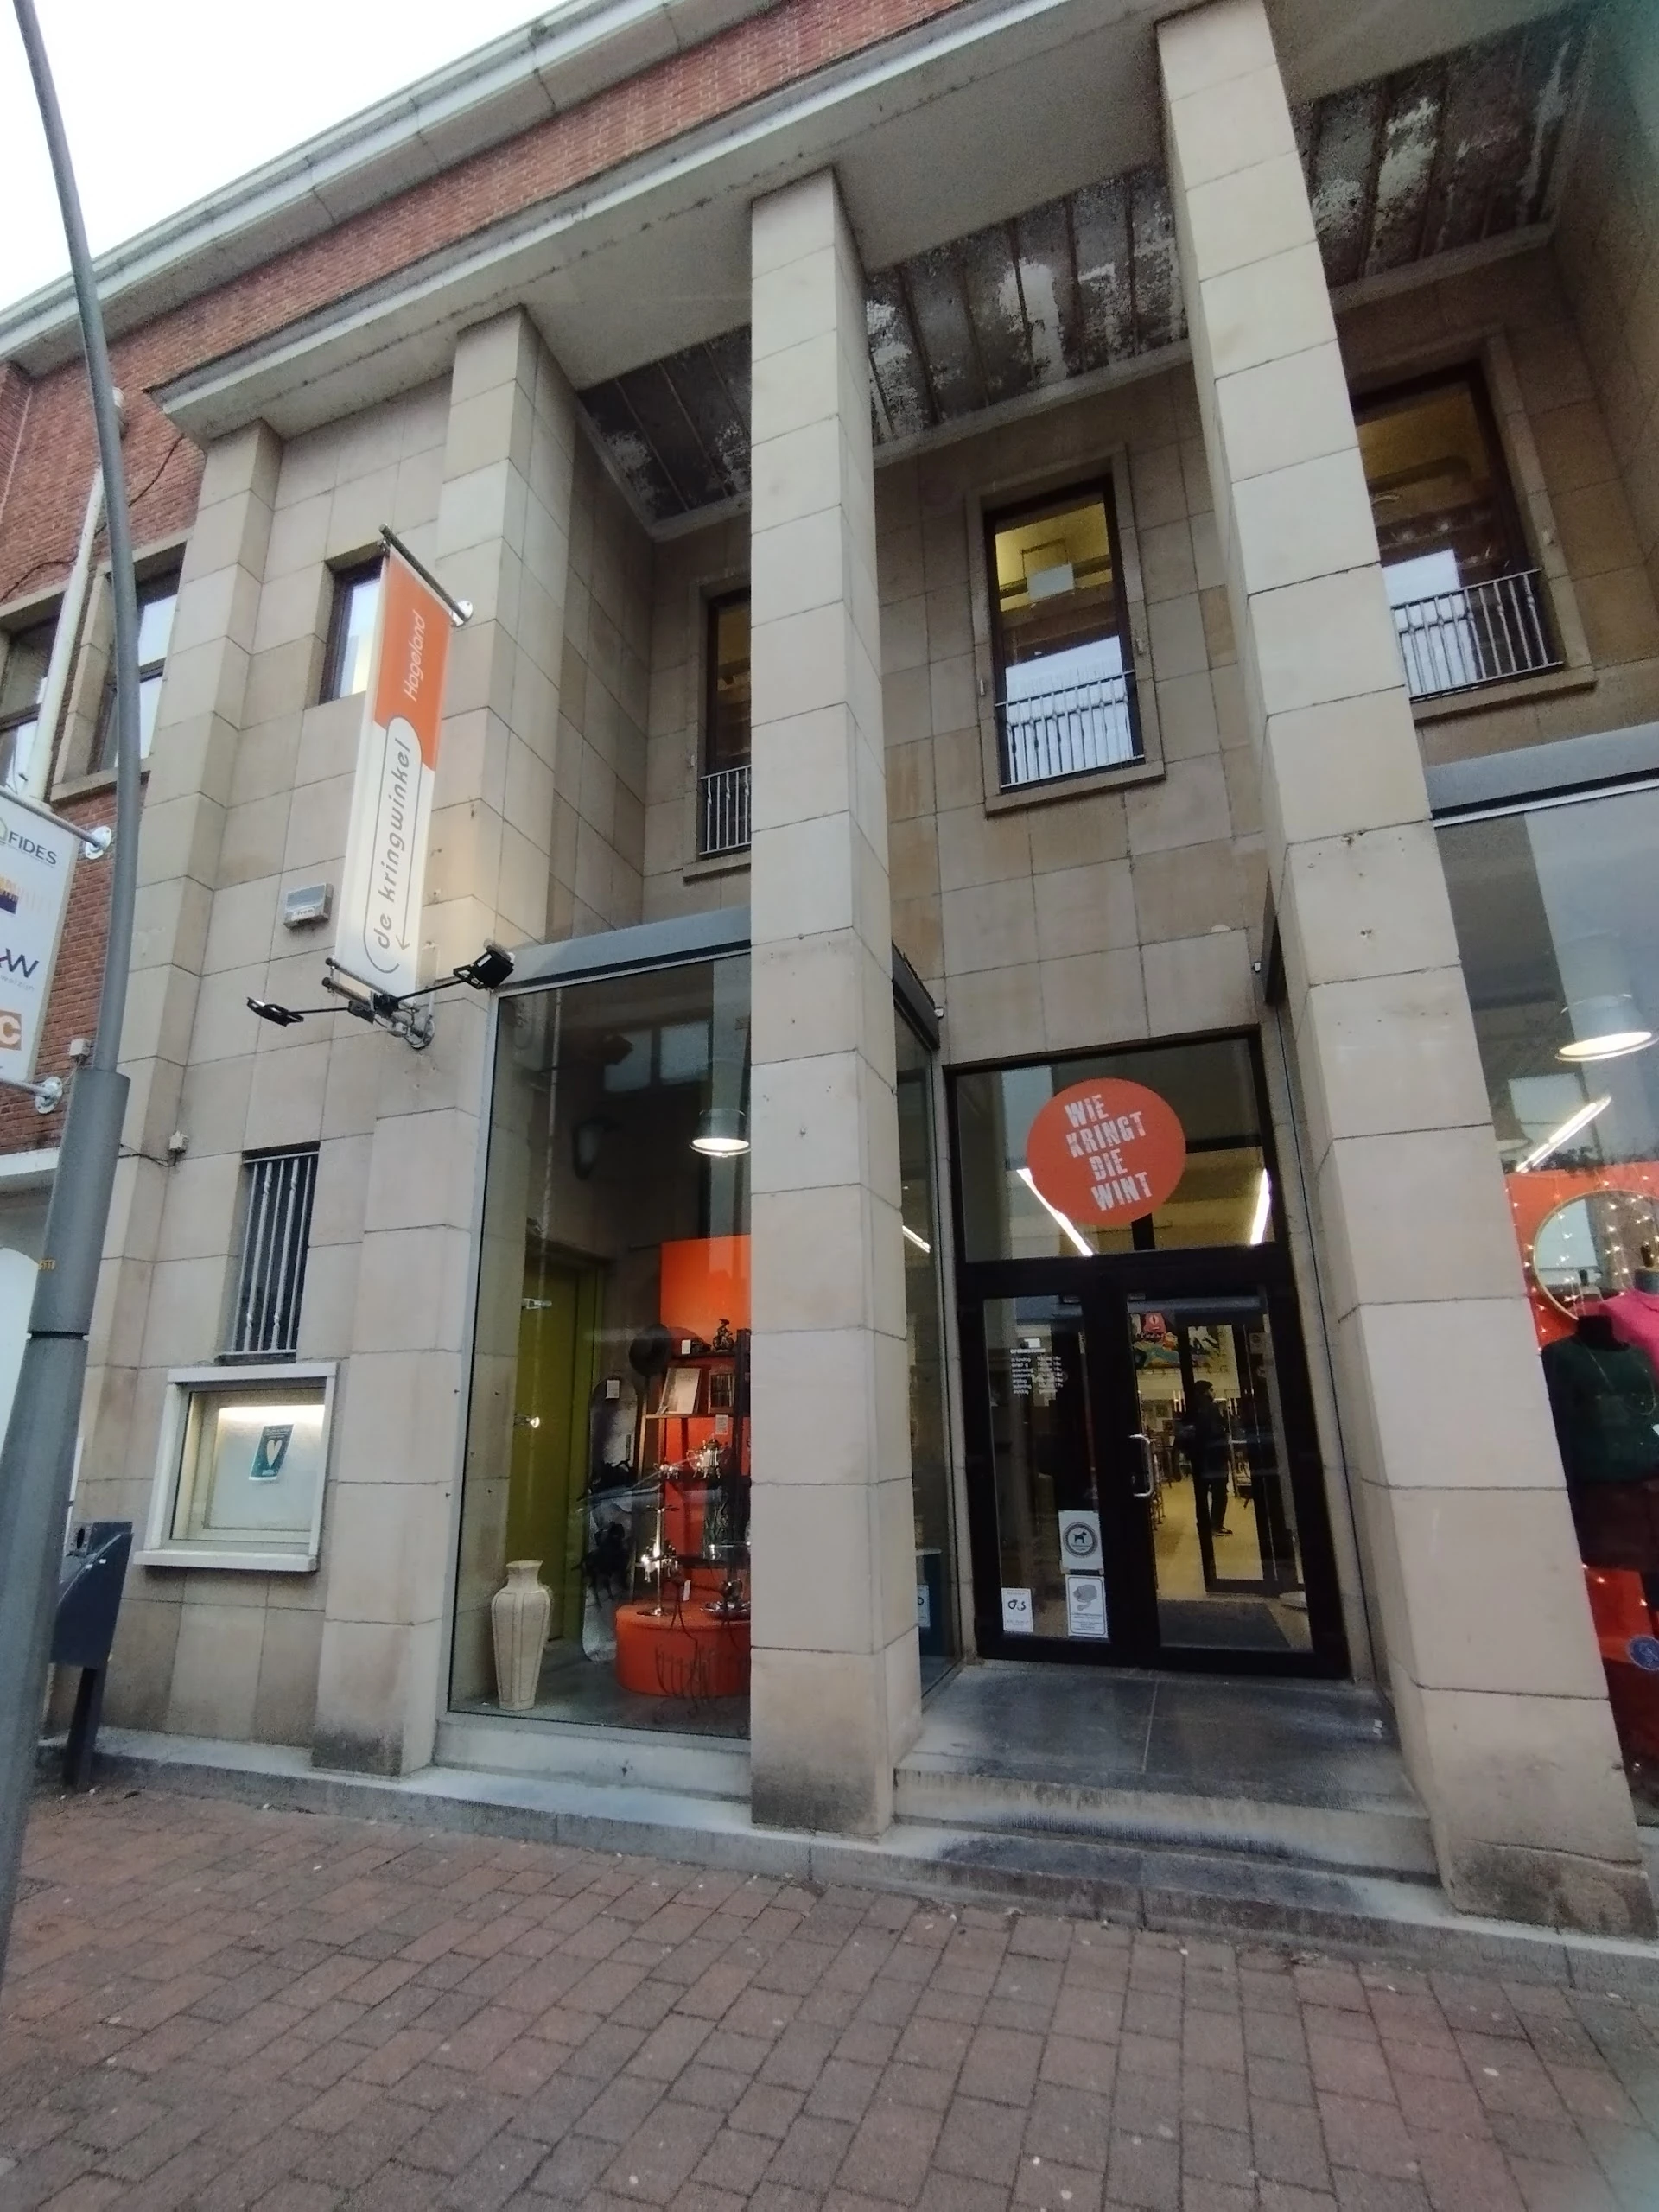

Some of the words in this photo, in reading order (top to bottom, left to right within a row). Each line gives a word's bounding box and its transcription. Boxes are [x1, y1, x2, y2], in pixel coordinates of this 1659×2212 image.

[403, 608, 425, 702] Hogeland
[378, 737, 411, 903] kringwinkel
[8, 831, 57, 865] FIDES
[373, 912, 393, 950] de
[1064, 1094, 1109, 1128] WIE
[1065, 1111, 1147, 1159] KRINGT
[1089, 1148, 1128, 1182] DIE
[1090, 1172, 1152, 1211] WINT
